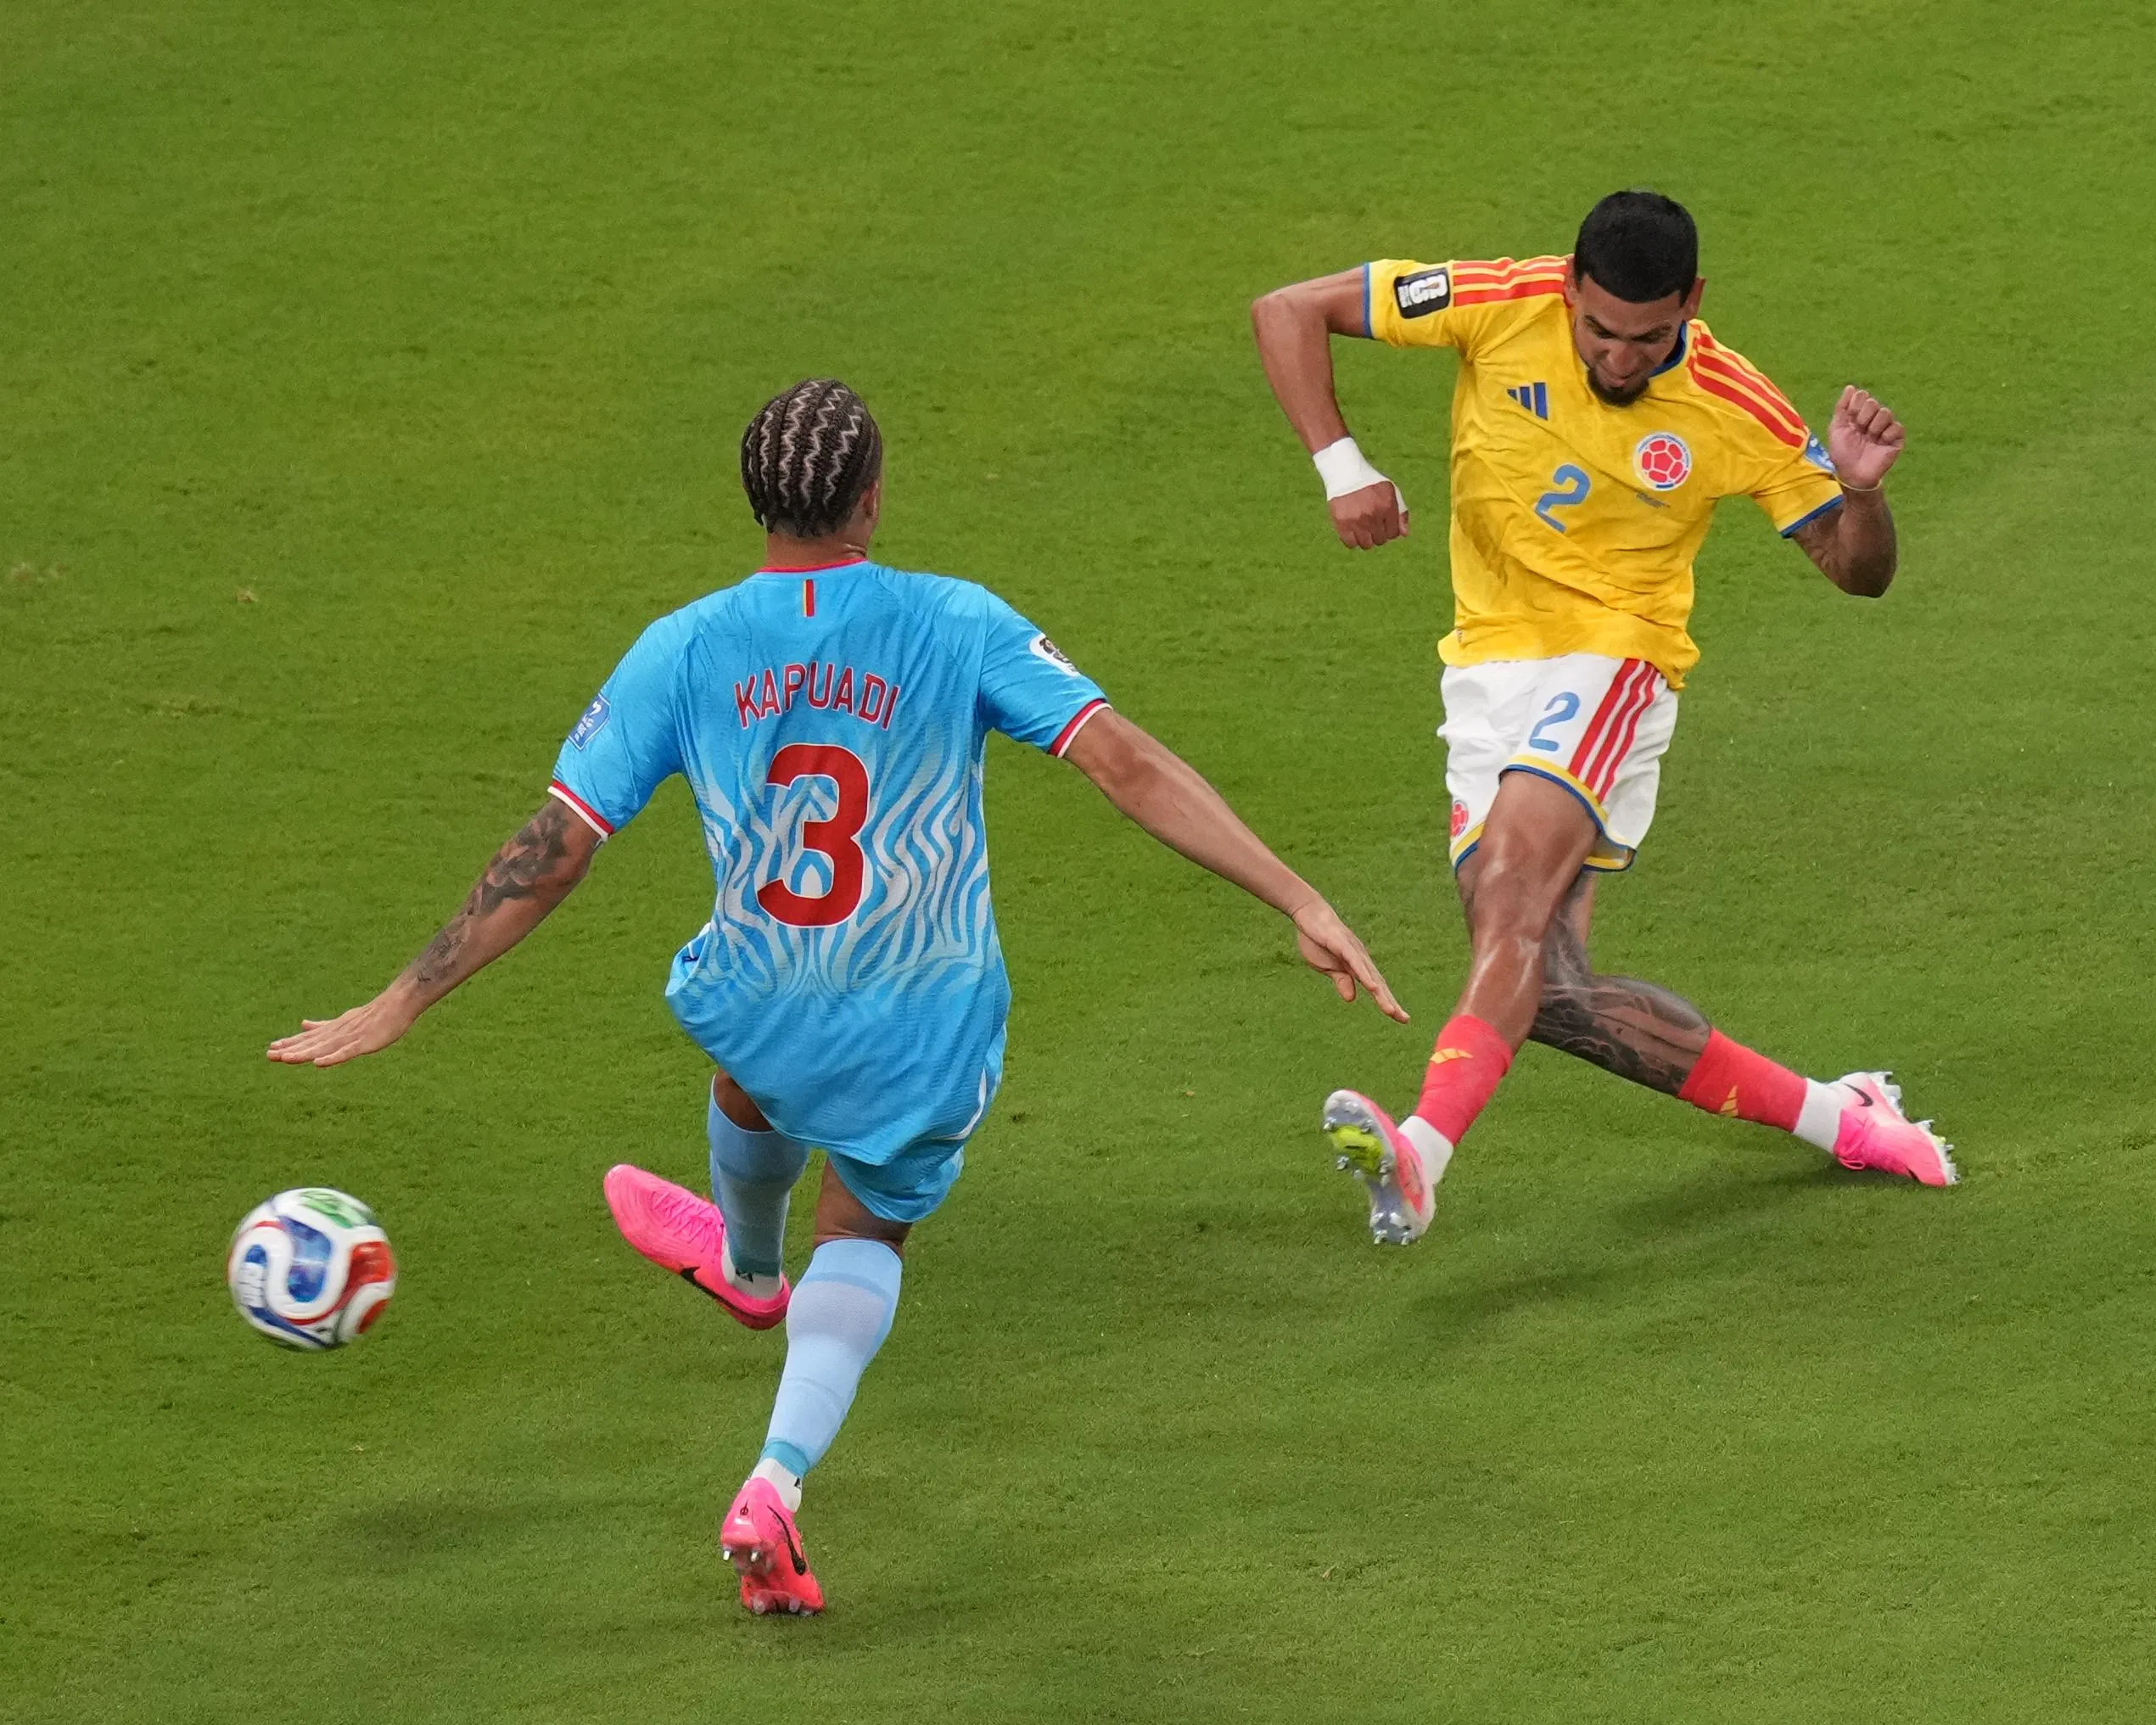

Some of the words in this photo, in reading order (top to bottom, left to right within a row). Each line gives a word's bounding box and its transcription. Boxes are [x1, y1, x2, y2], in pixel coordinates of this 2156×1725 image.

[1534, 463, 1591, 534] 2
[735, 661, 900, 731] KAPUADI
[1529, 692, 1581, 752] 2
[757, 743, 870, 927] 3
